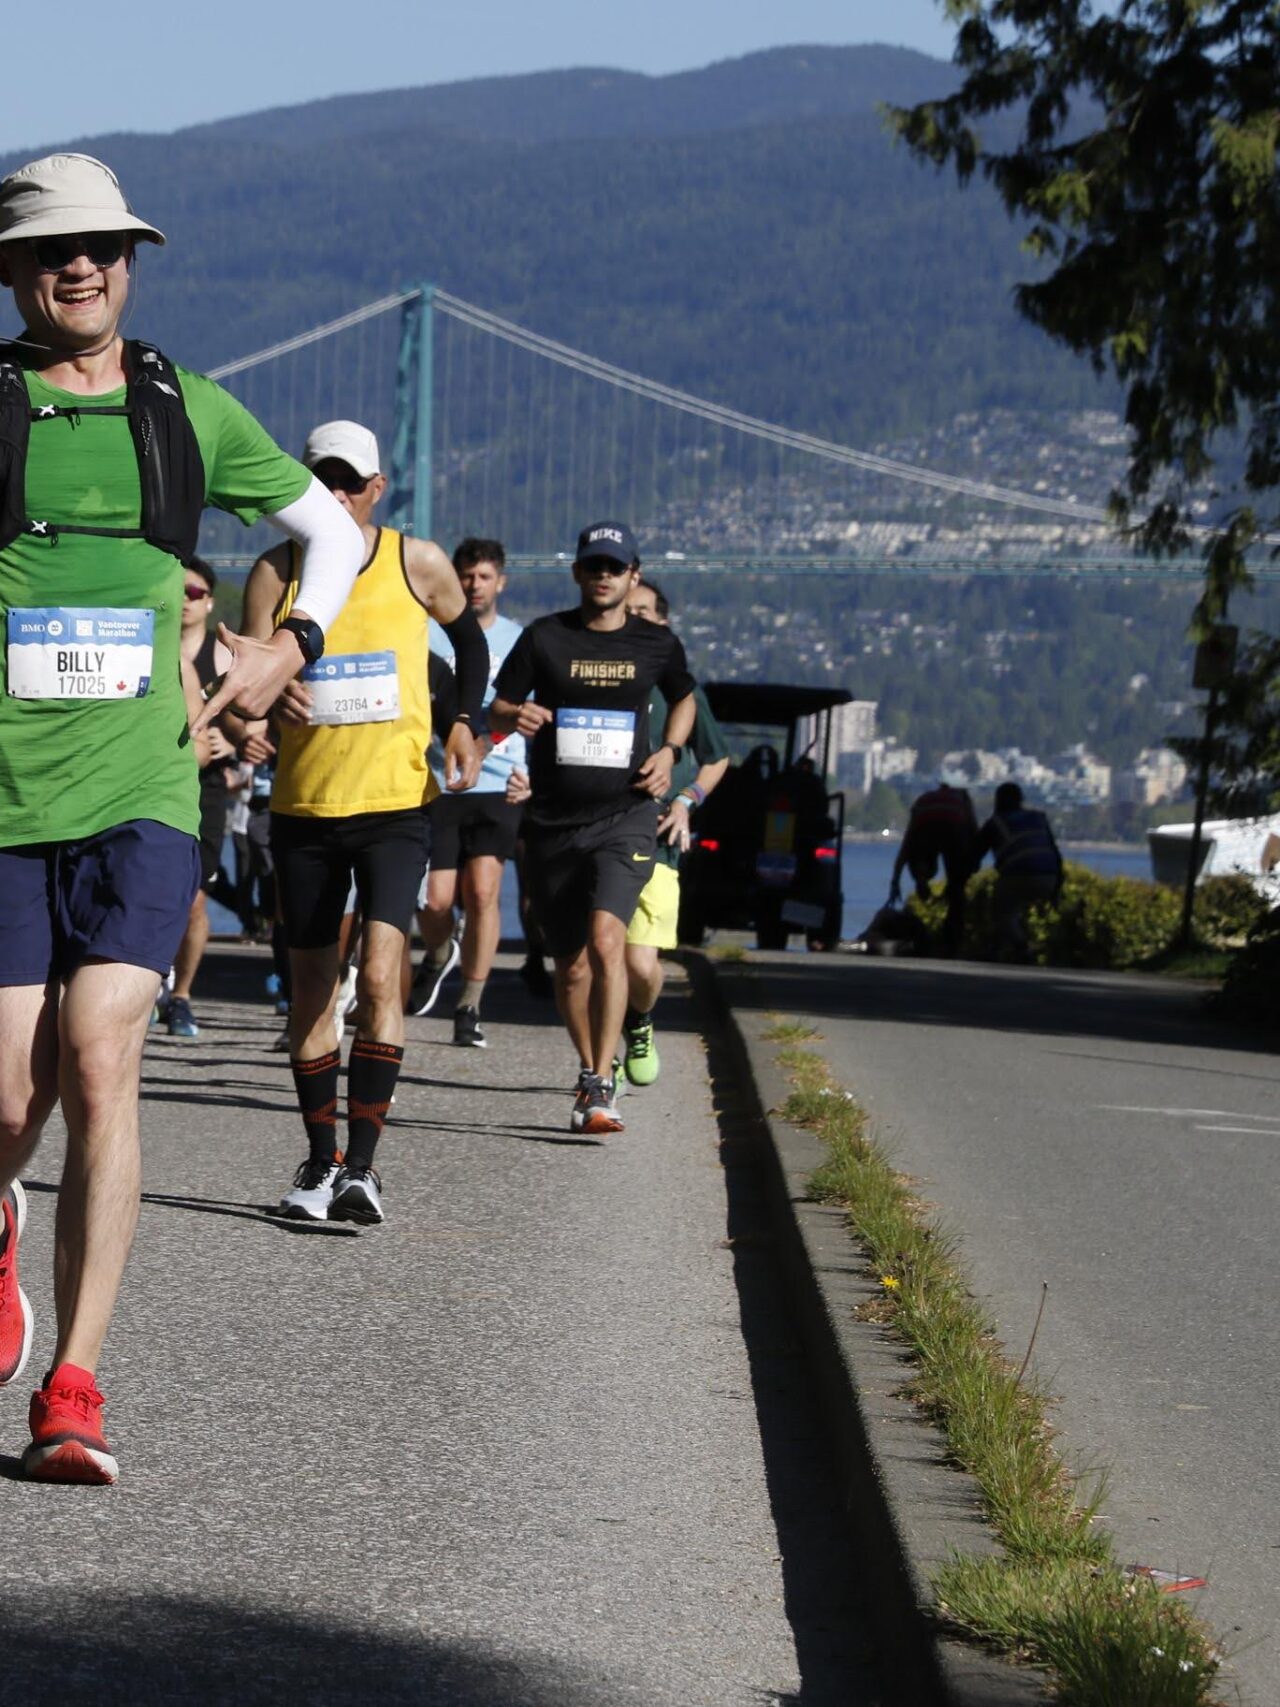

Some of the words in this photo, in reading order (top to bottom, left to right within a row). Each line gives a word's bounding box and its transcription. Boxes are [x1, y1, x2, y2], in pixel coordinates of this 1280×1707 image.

[589, 528, 623, 543] NIKE
[20, 623, 46, 633] BMO
[97, 621, 140, 630] Vancouver
[97, 629, 137, 638] Marathon
[57, 651, 105, 673] BILLY
[570, 664, 636, 679] FINISHER
[59, 676, 106, 695] 17025
[334, 698, 368, 713] 23764
